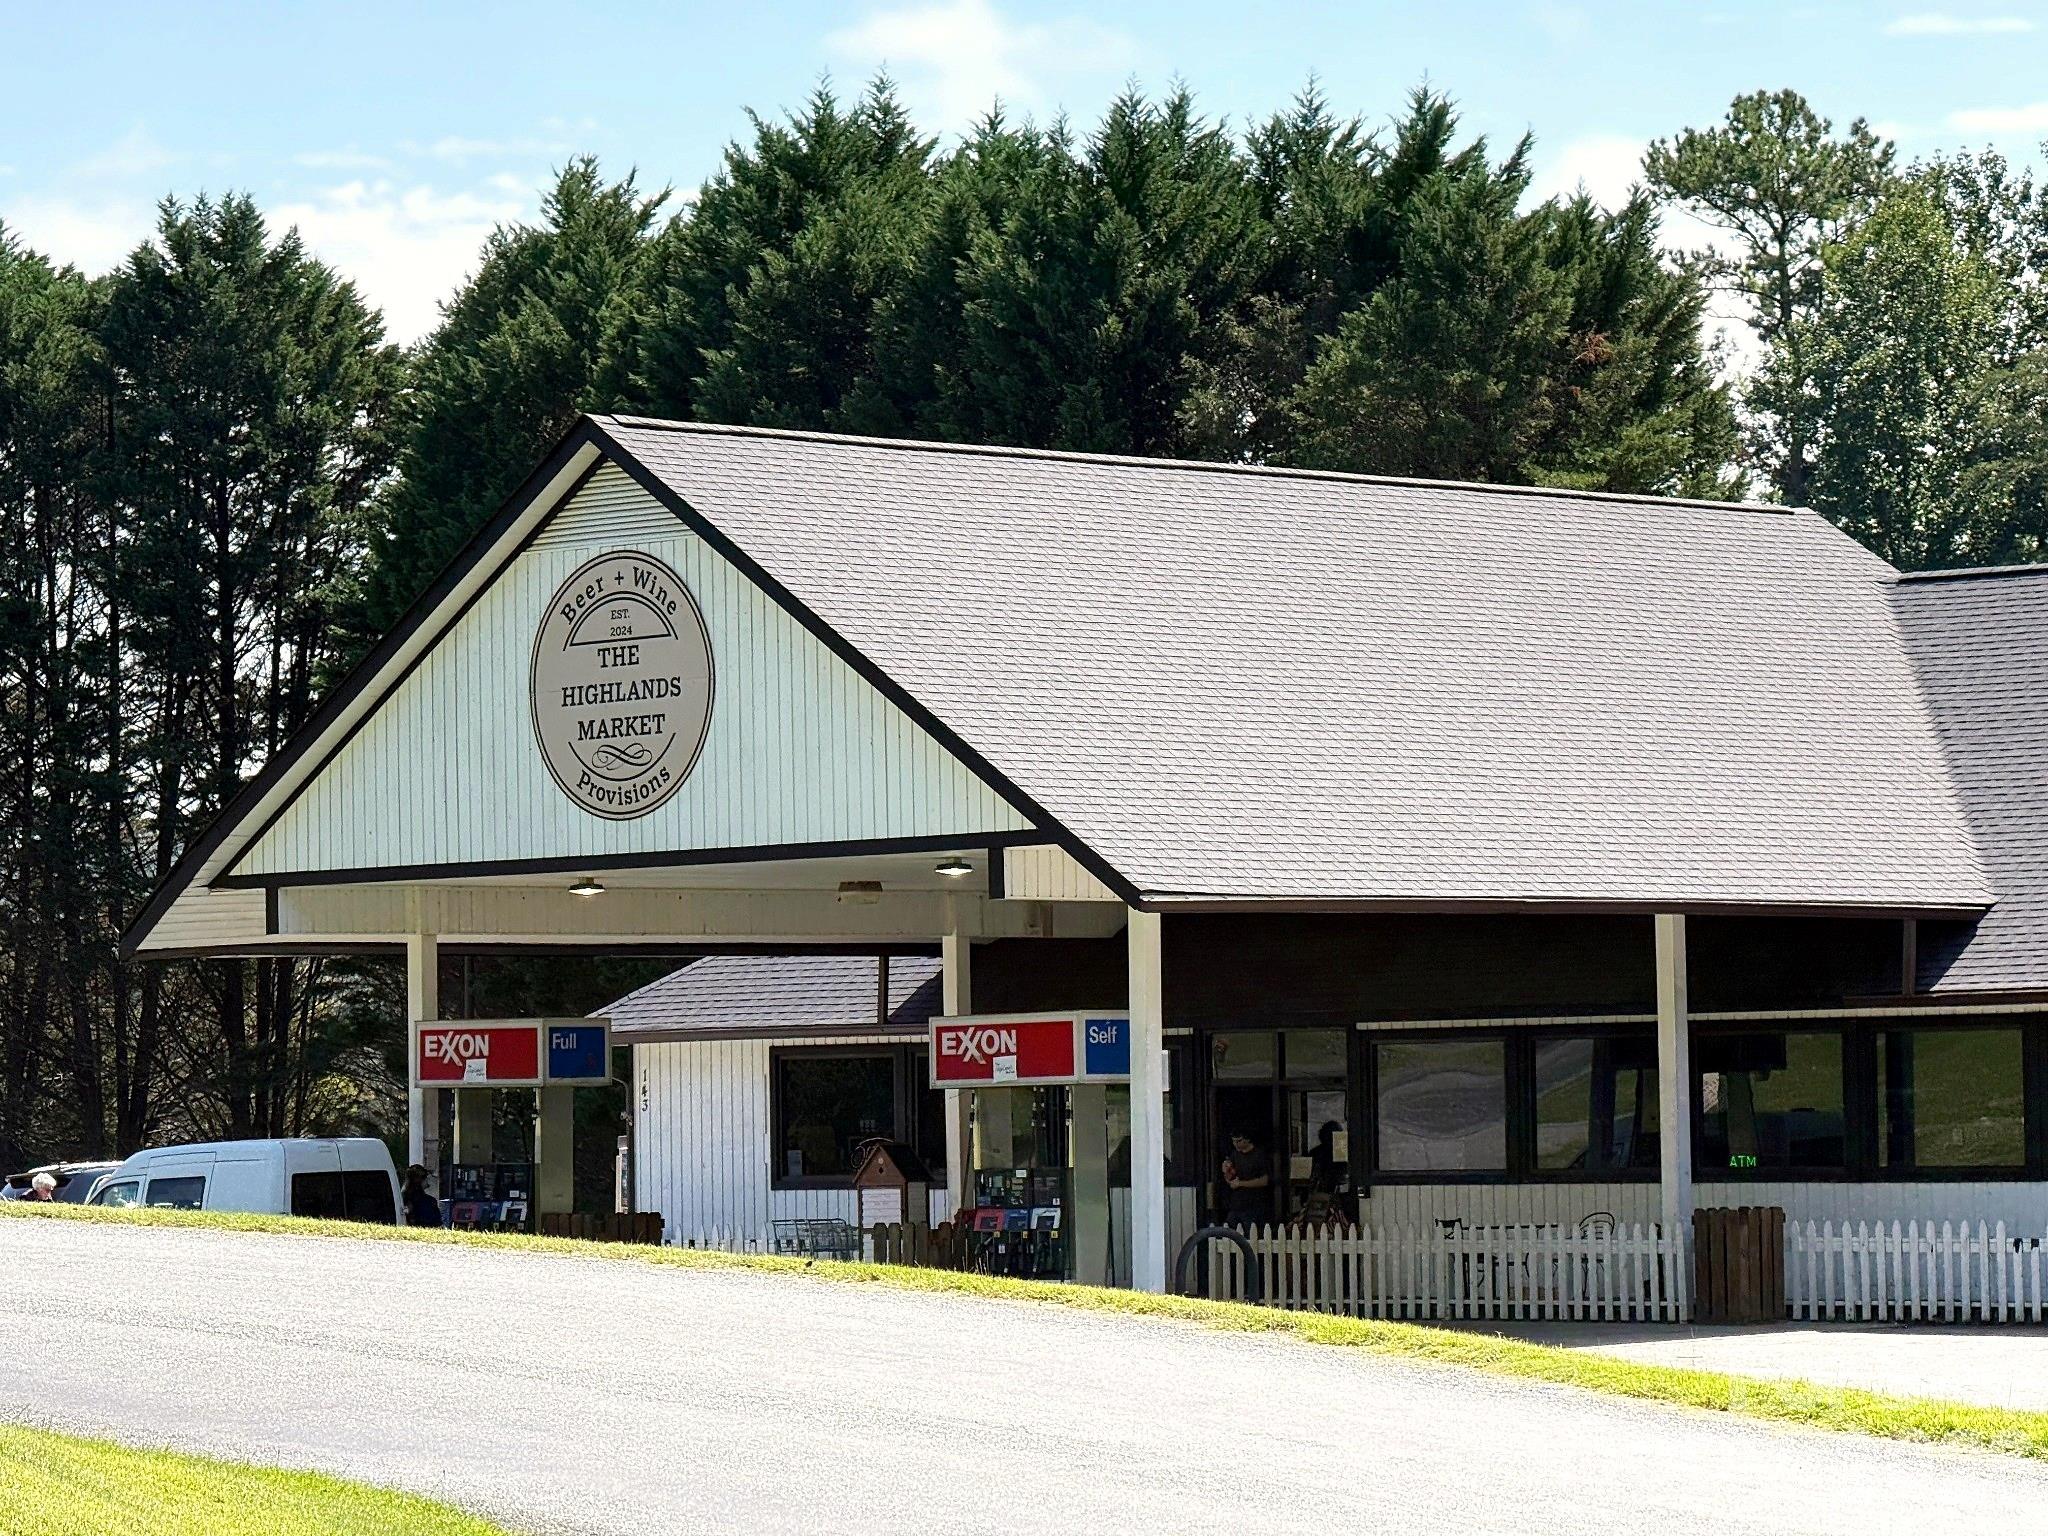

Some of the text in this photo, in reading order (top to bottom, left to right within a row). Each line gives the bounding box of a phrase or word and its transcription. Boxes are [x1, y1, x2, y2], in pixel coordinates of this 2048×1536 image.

[560, 575, 604, 625] Beer
[632, 566, 678, 616] Wine
[610, 609, 631, 621] EST.
[610, 625, 633, 638] 2024
[597, 645, 640, 669] THE
[561, 676, 682, 708] HIGHLANDS
[577, 713, 666, 742] MARKET
[575, 765, 672, 807] Provisions
[552, 1032, 577, 1050] Full
[941, 1026, 1018, 1065] EXXON
[1088, 1025, 1118, 1044] Self
[424, 1031, 490, 1067] EXXON
[1729, 1155, 1757, 1168] ATM
